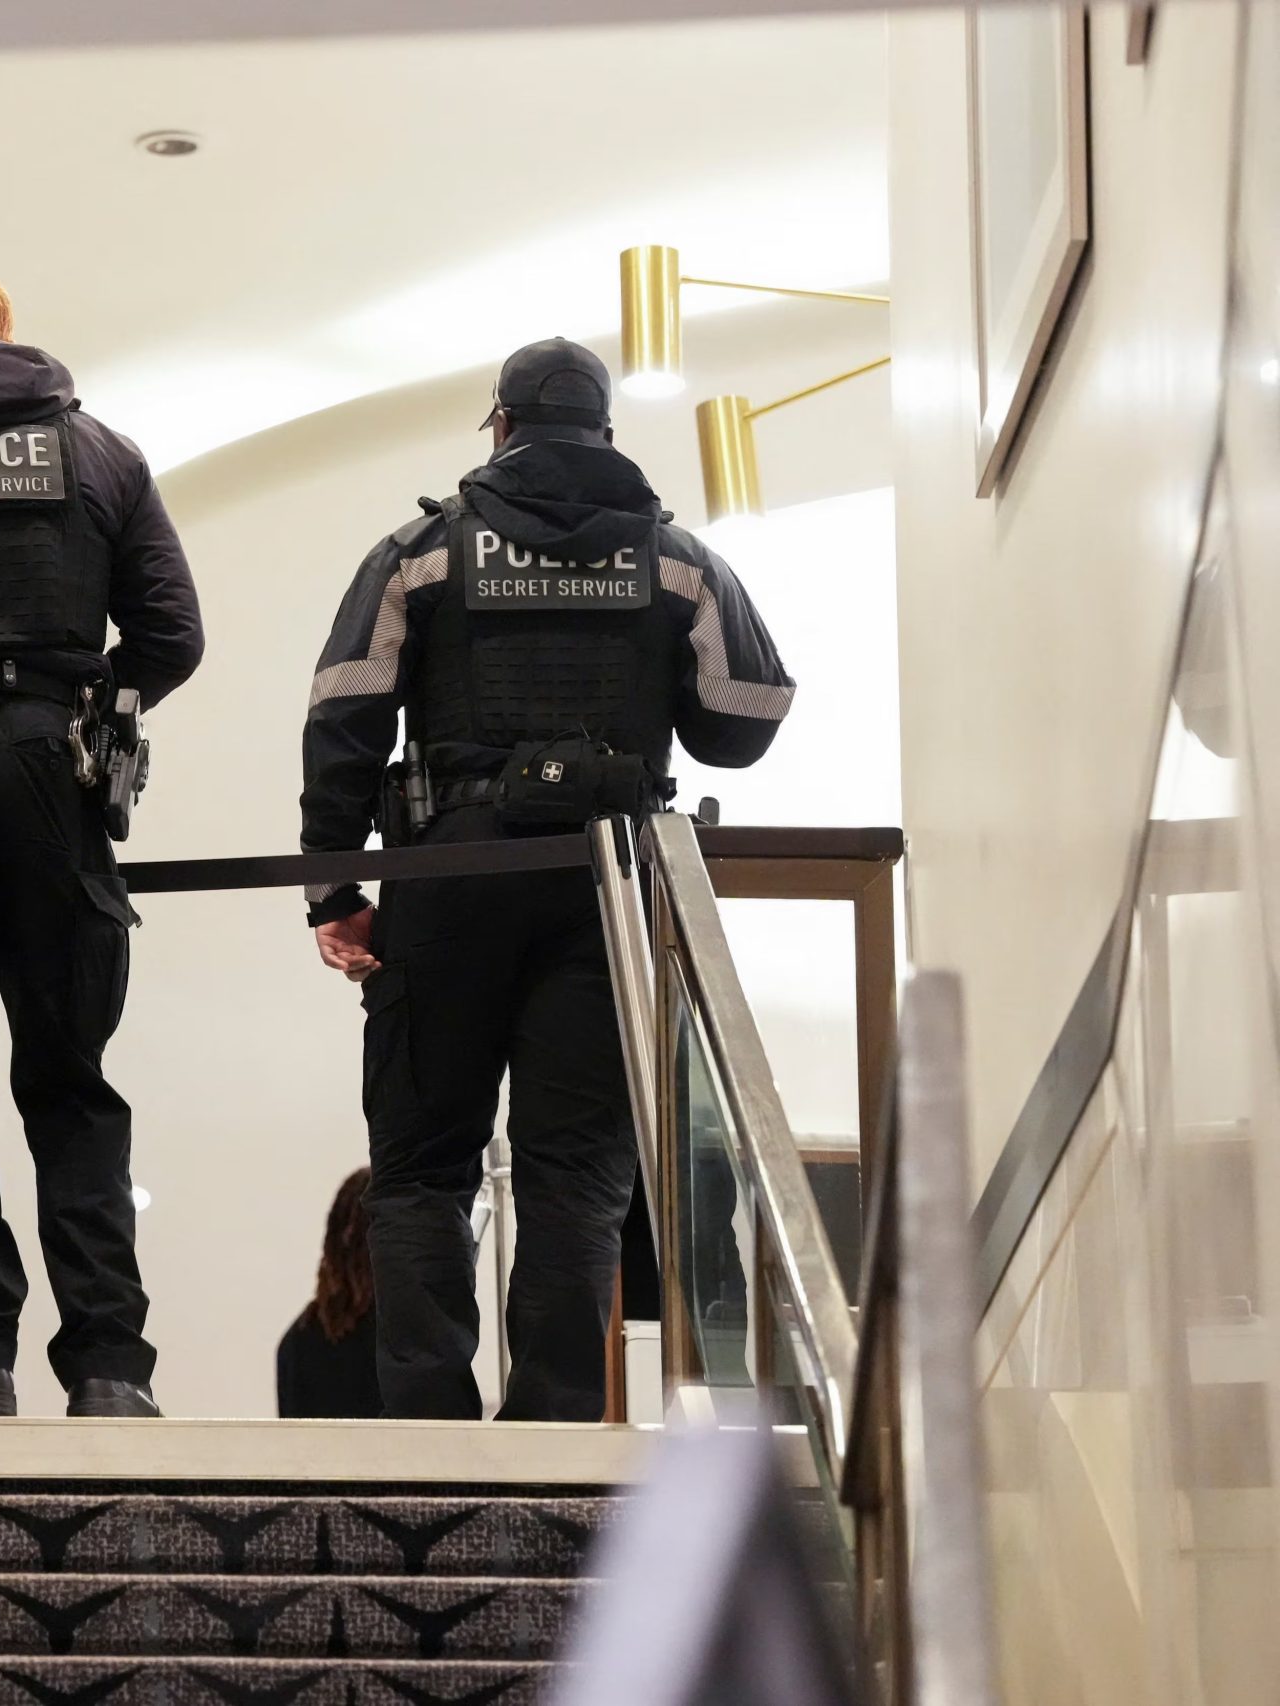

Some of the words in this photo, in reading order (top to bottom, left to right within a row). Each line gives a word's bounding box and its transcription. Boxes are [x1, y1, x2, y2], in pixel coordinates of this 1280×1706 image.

[475, 530, 637, 570] POLE
[477, 579, 550, 597] SECRET
[558, 579, 638, 597] SERVICE
